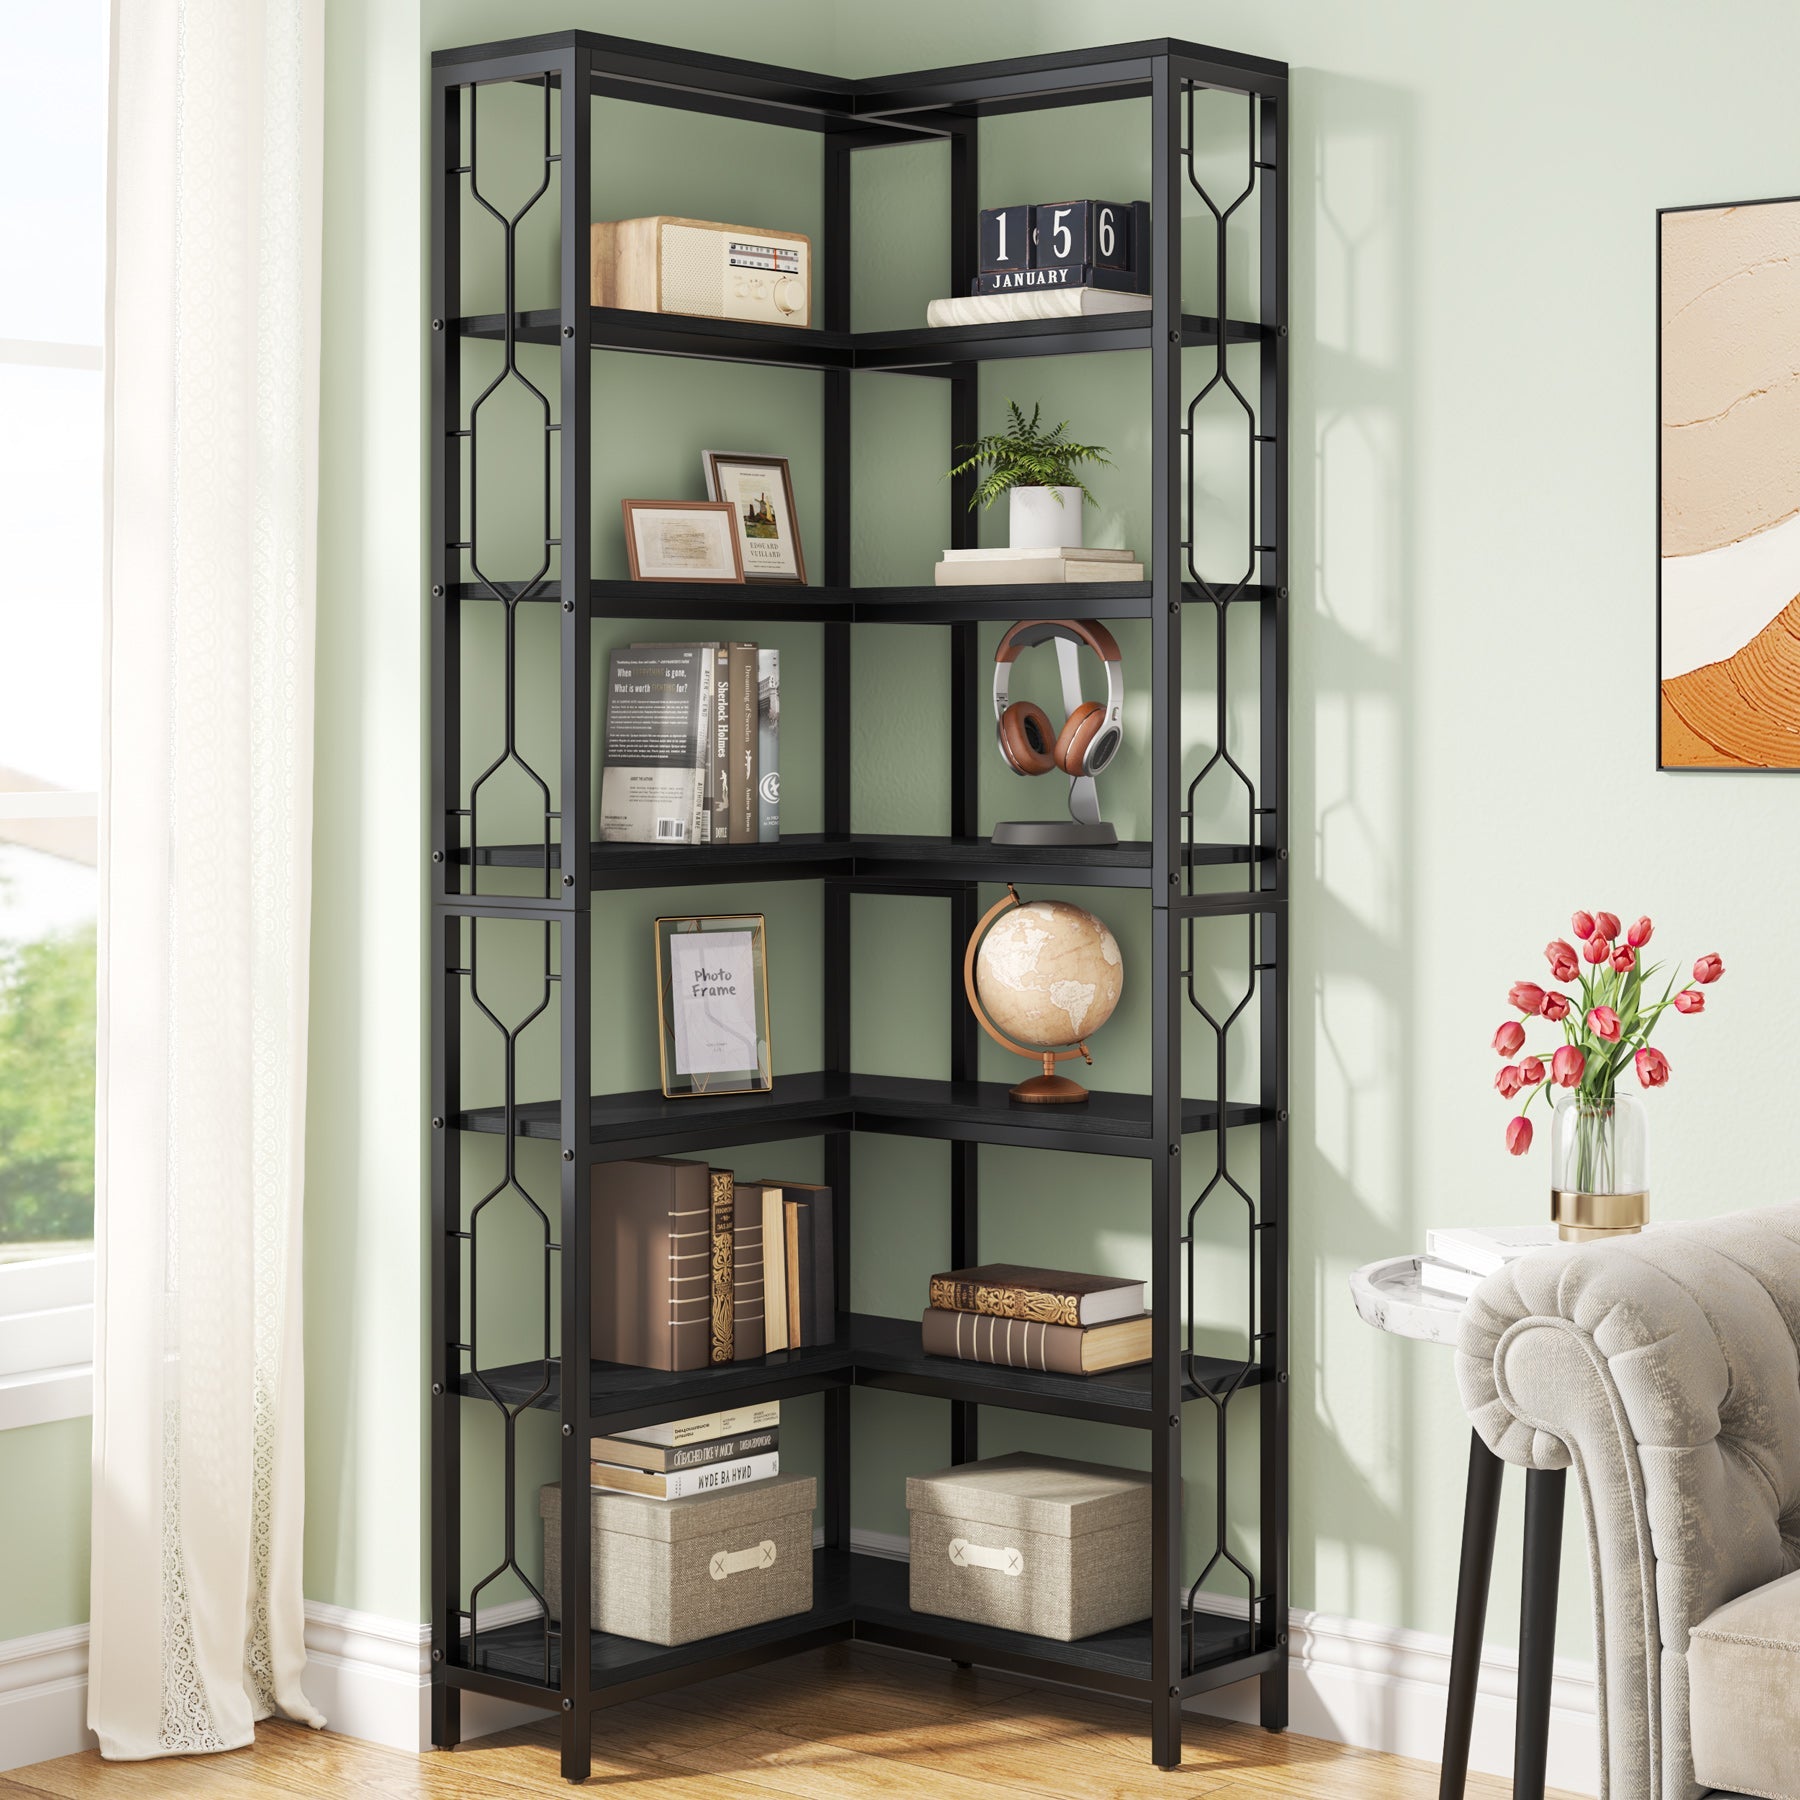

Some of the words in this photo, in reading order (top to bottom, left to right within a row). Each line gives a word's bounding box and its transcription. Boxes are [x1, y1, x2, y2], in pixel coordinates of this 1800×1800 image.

[996, 211, 1009, 261] 1
[1053, 208, 1072, 259] 5
[1099, 208, 1115, 257] 6
[992, 269, 1069, 289] JANUARY
[617, 668, 632, 677] When
[665, 667, 671, 677] is
[614, 683, 628, 693] What
[629, 683, 634, 693] is
[635, 683, 651, 693] worth
[676, 683, 688, 693] for?
[743, 665, 752, 703] Dreaming
[717, 681, 728, 721] Sherlock
[744, 703, 752, 712] of
[744, 713, 752, 743] Sweden
[717, 724, 728, 758] Holmes
[694, 968, 732, 982] Photo
[692, 984, 737, 997] Frame
